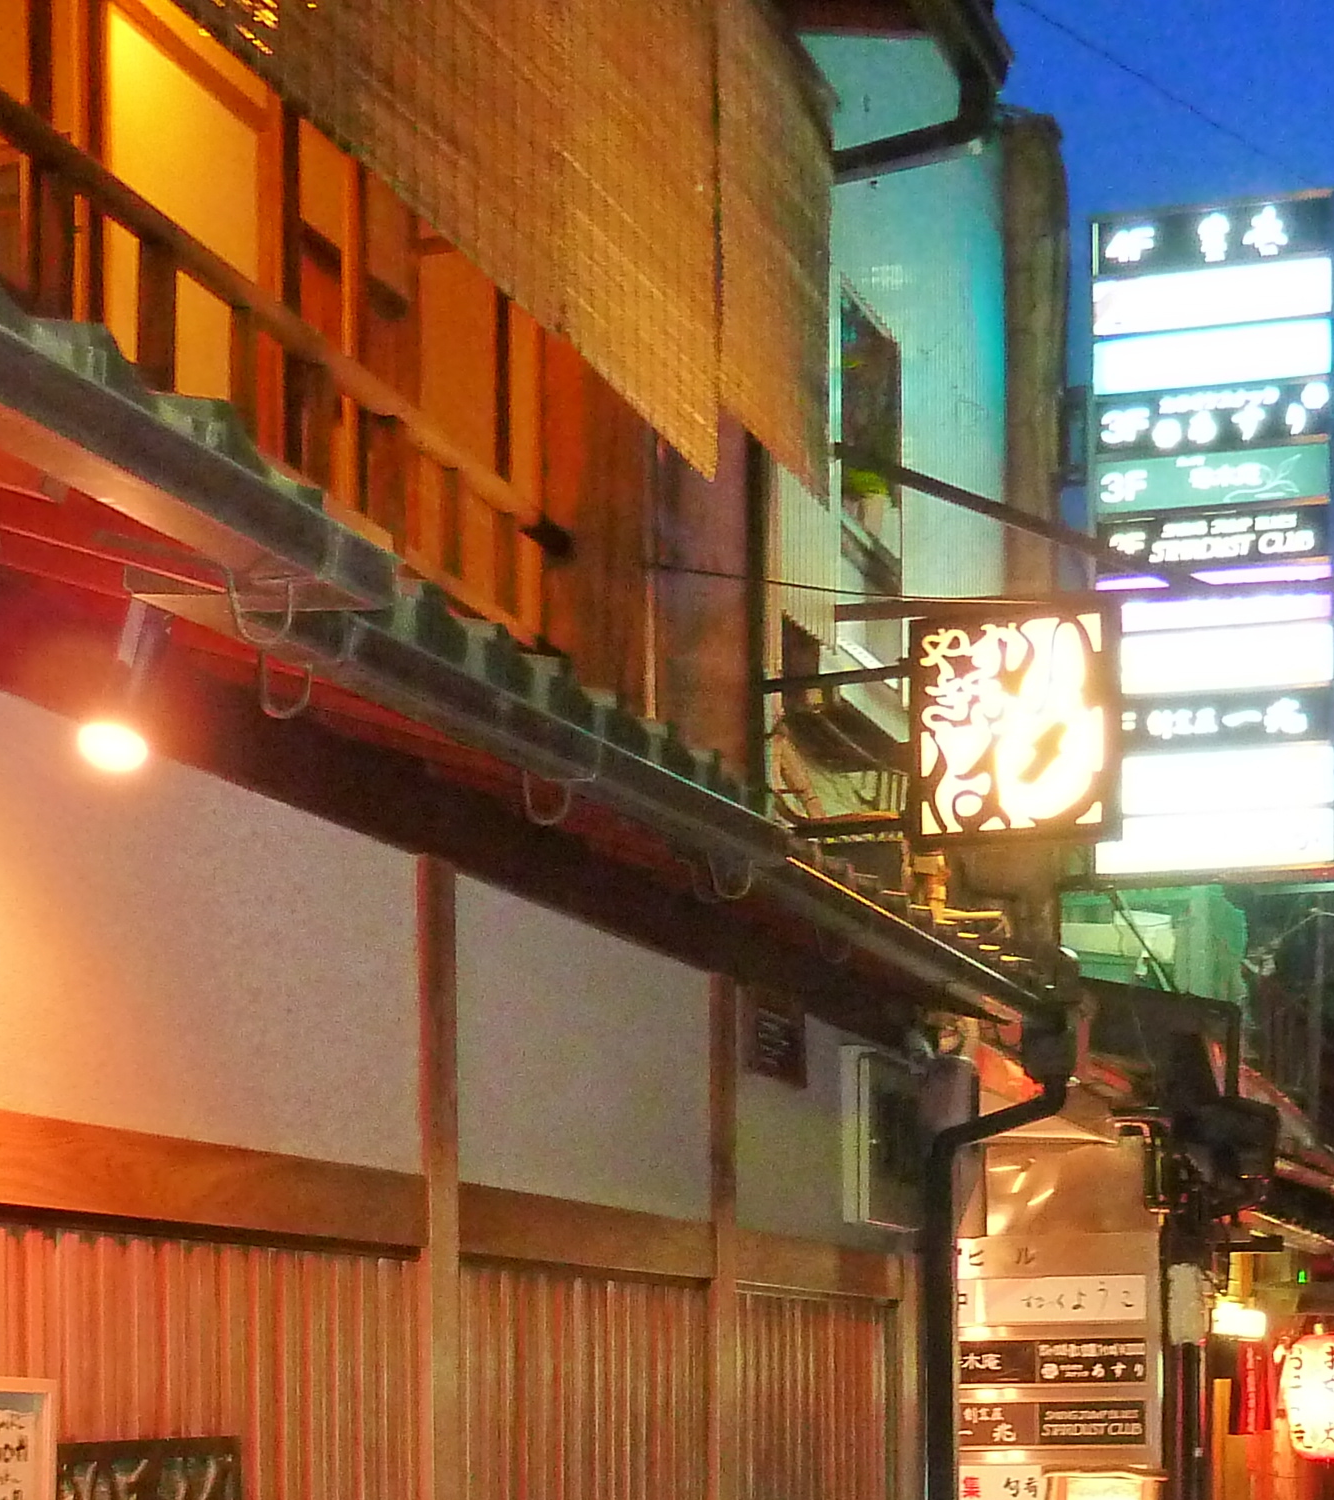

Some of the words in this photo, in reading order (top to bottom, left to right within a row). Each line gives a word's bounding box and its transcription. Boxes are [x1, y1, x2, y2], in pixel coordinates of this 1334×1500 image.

[1100, 407, 1149, 444] 3F
[1100, 470, 1148, 503] 3F
[1258, 529, 1314, 554] CLUB
[1040, 1423, 1108, 1437] STARDUST
[1107, 1423, 1143, 1436] CLUB
